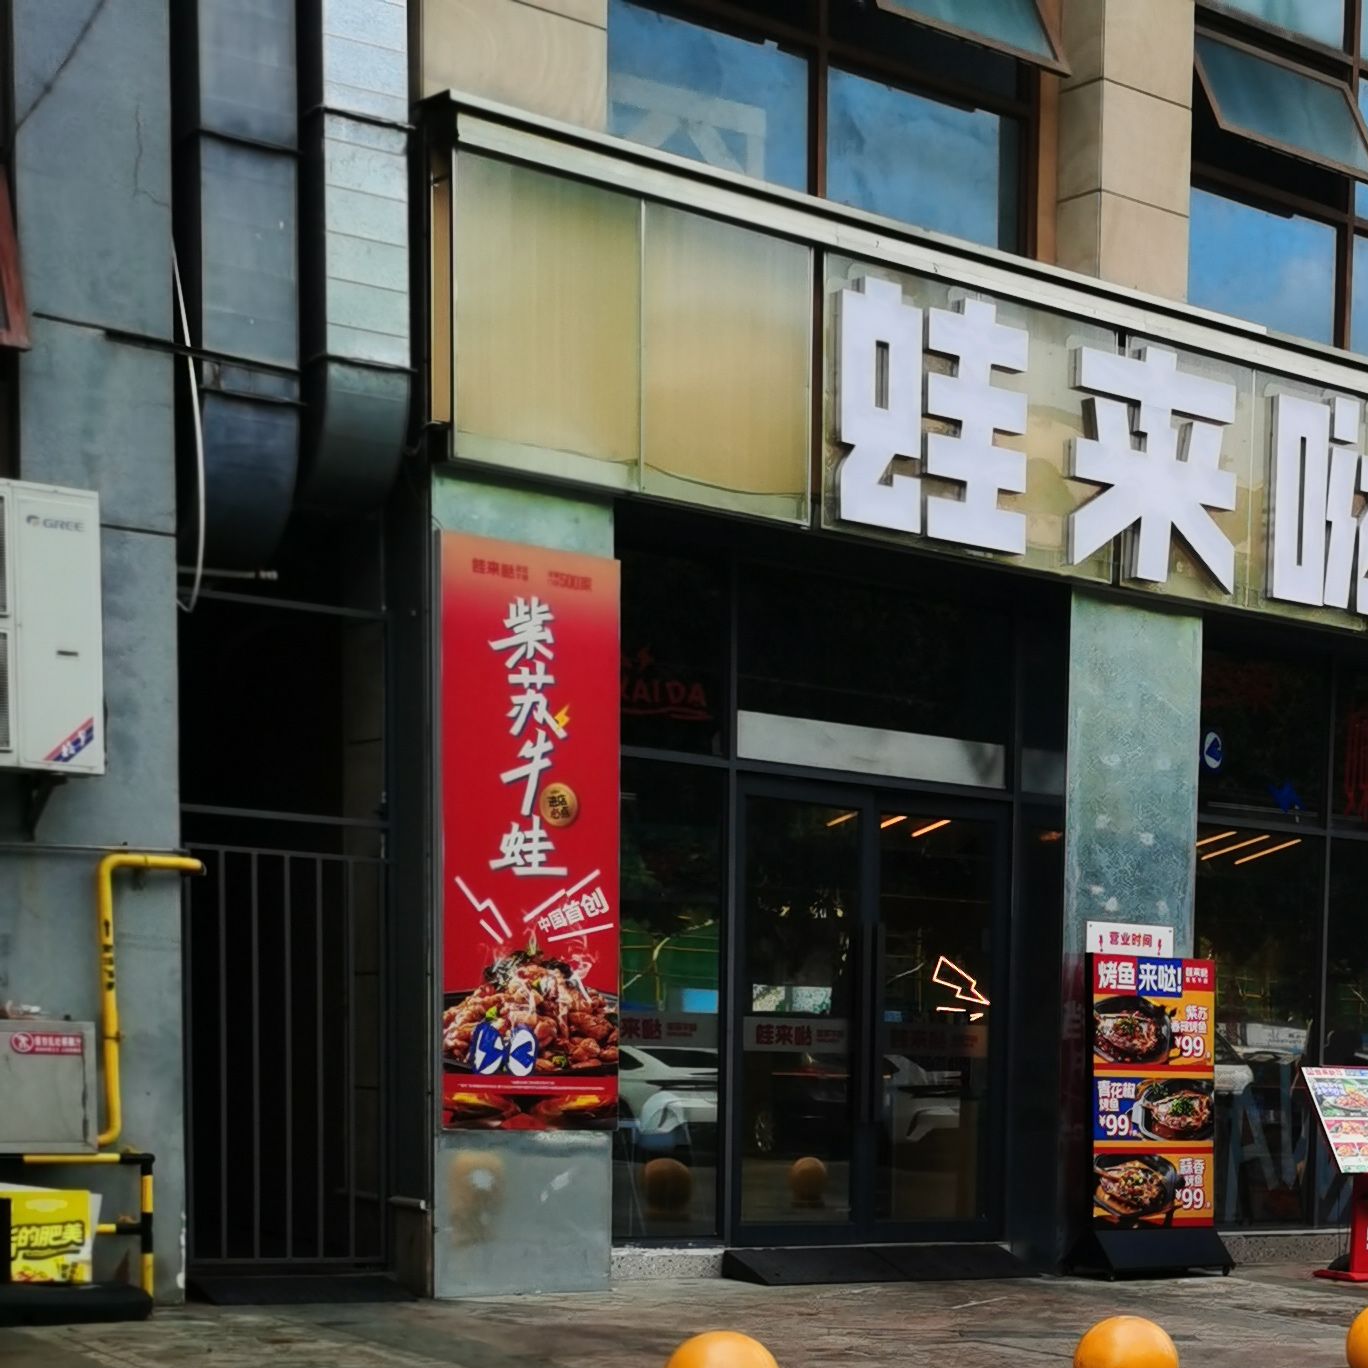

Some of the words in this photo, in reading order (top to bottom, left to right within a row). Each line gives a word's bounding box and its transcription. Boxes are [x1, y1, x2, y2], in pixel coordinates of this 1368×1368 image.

[43, 518, 87, 533] GREE
[487, 595, 568, 877] 紫苏牛蛙
[538, 886, 610, 933] 中国首创
[1109, 930, 1153, 948] 营业时间
